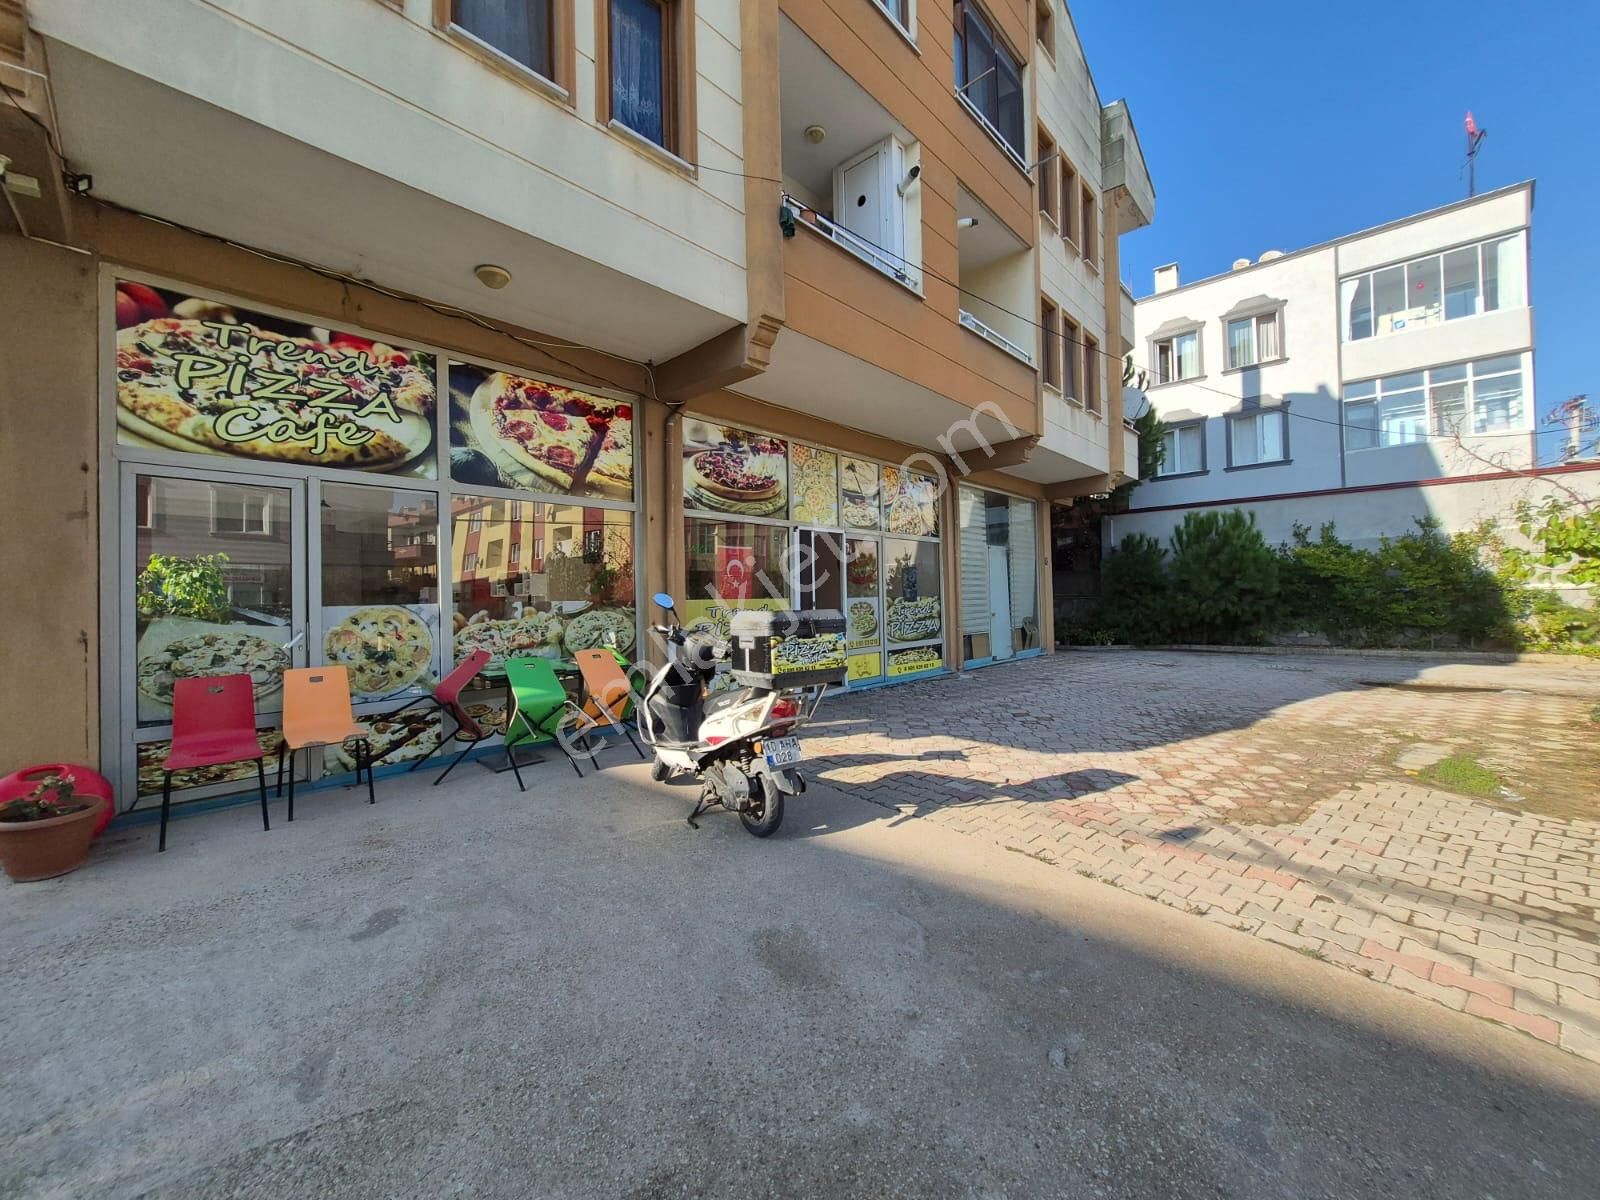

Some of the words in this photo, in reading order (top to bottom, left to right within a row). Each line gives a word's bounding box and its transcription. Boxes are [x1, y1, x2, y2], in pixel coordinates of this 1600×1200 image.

[201, 320, 380, 376] Trend
[213, 406, 376, 455] Cafe
[895, 602, 931, 616] Trend
[766, 741, 777, 752] 10
[775, 751, 793, 763] 028
